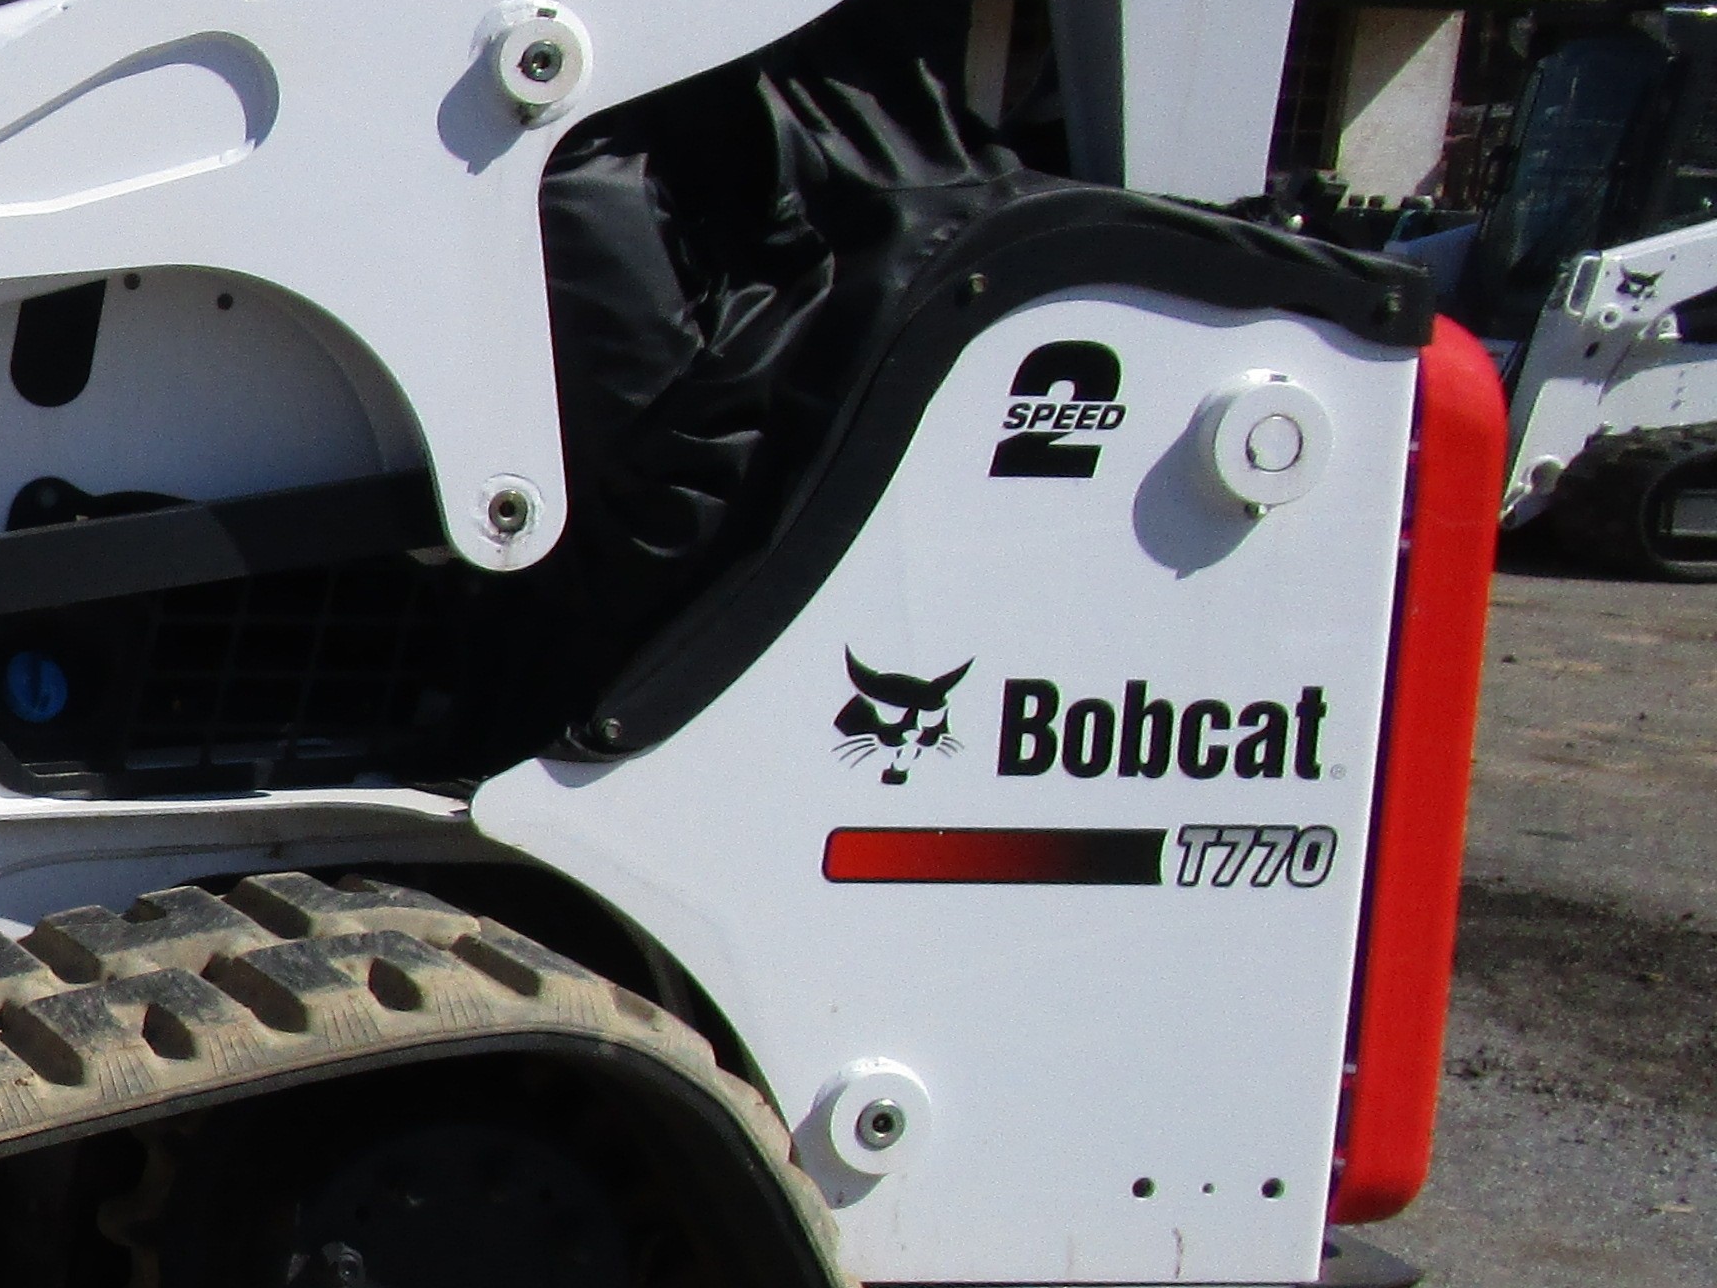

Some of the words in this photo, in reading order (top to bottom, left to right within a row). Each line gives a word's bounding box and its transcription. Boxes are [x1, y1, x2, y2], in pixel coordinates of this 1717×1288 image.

[1002, 402, 1127, 431] SPEED
[996, 678, 1328, 781] Bobcat
[1176, 824, 1338, 888] T770
